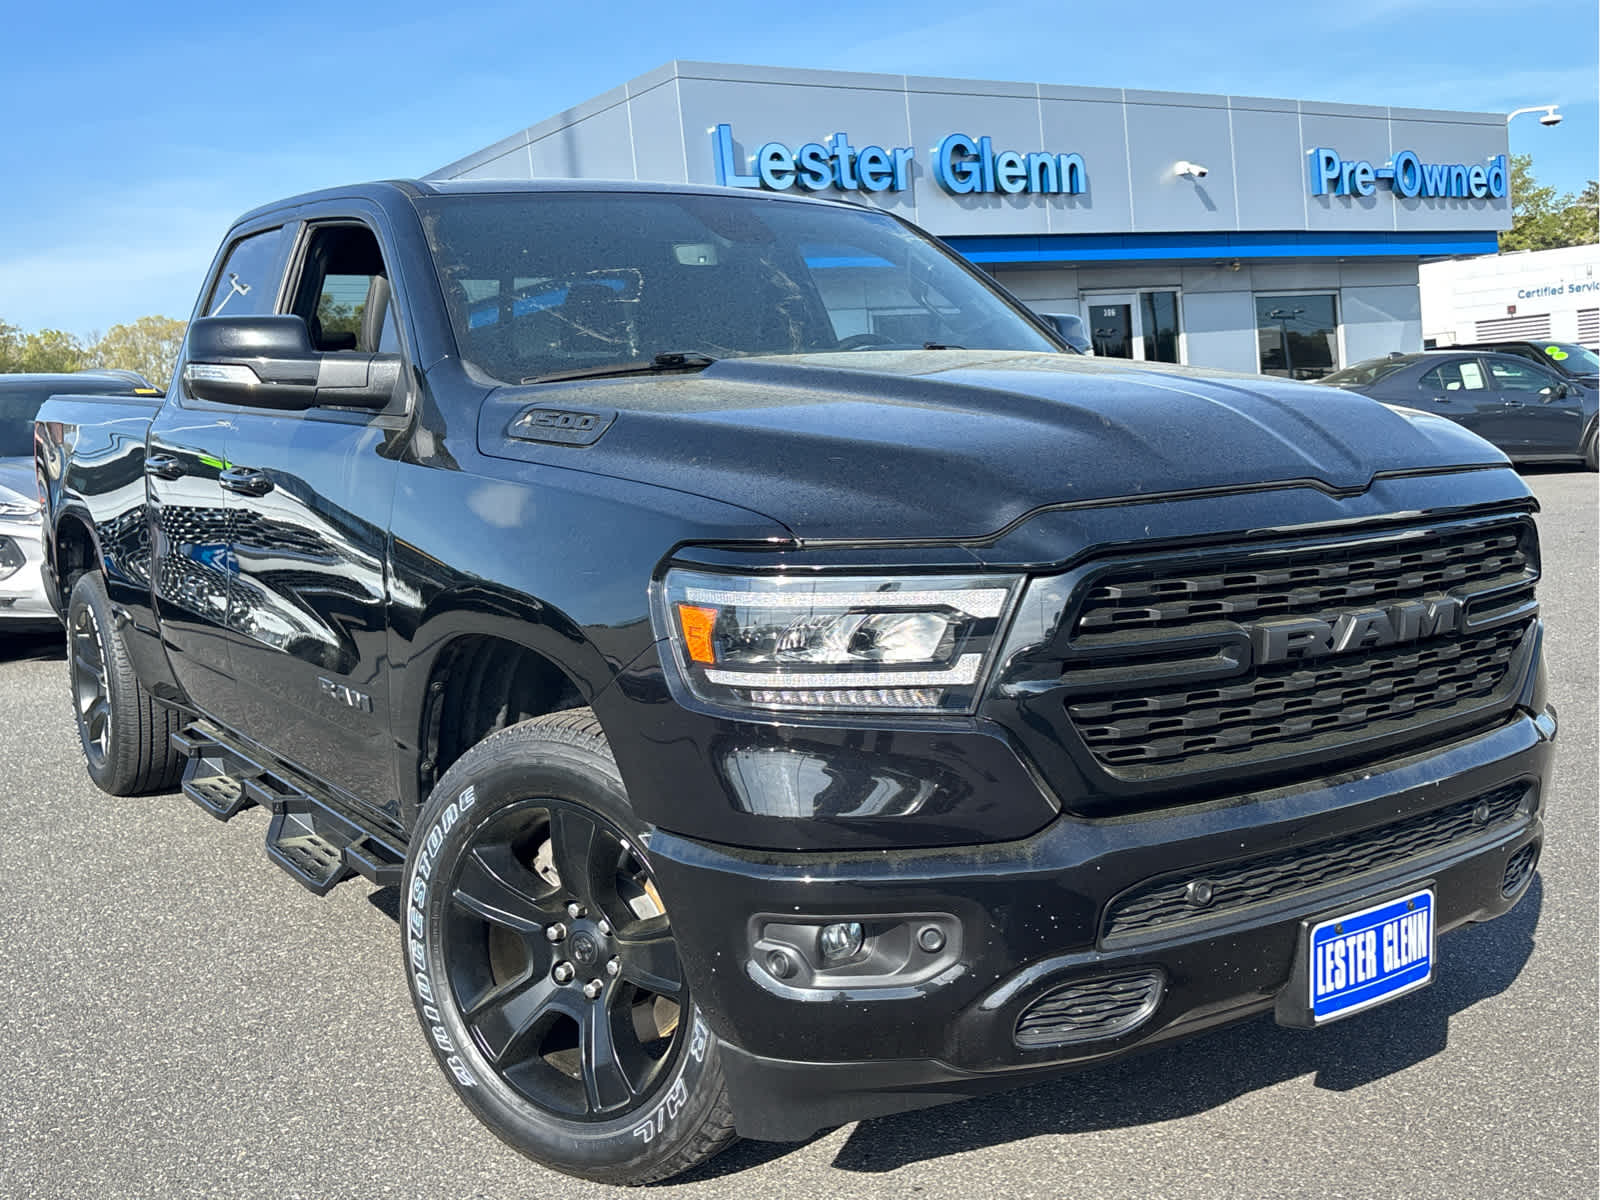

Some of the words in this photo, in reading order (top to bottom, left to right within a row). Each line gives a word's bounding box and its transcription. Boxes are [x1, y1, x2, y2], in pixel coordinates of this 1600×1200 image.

[711, 123, 914, 191] Lester
[934, 133, 1086, 194] Glenn
[1309, 147, 1507, 199] Pre-Owned
[1517, 284, 1564, 299] Certified
[1254, 596, 1459, 664] RAM
[408, 784, 478, 1088] BRIDGESTONE
[1316, 930, 1378, 996] LESTER
[1382, 911, 1428, 973] GLENN
